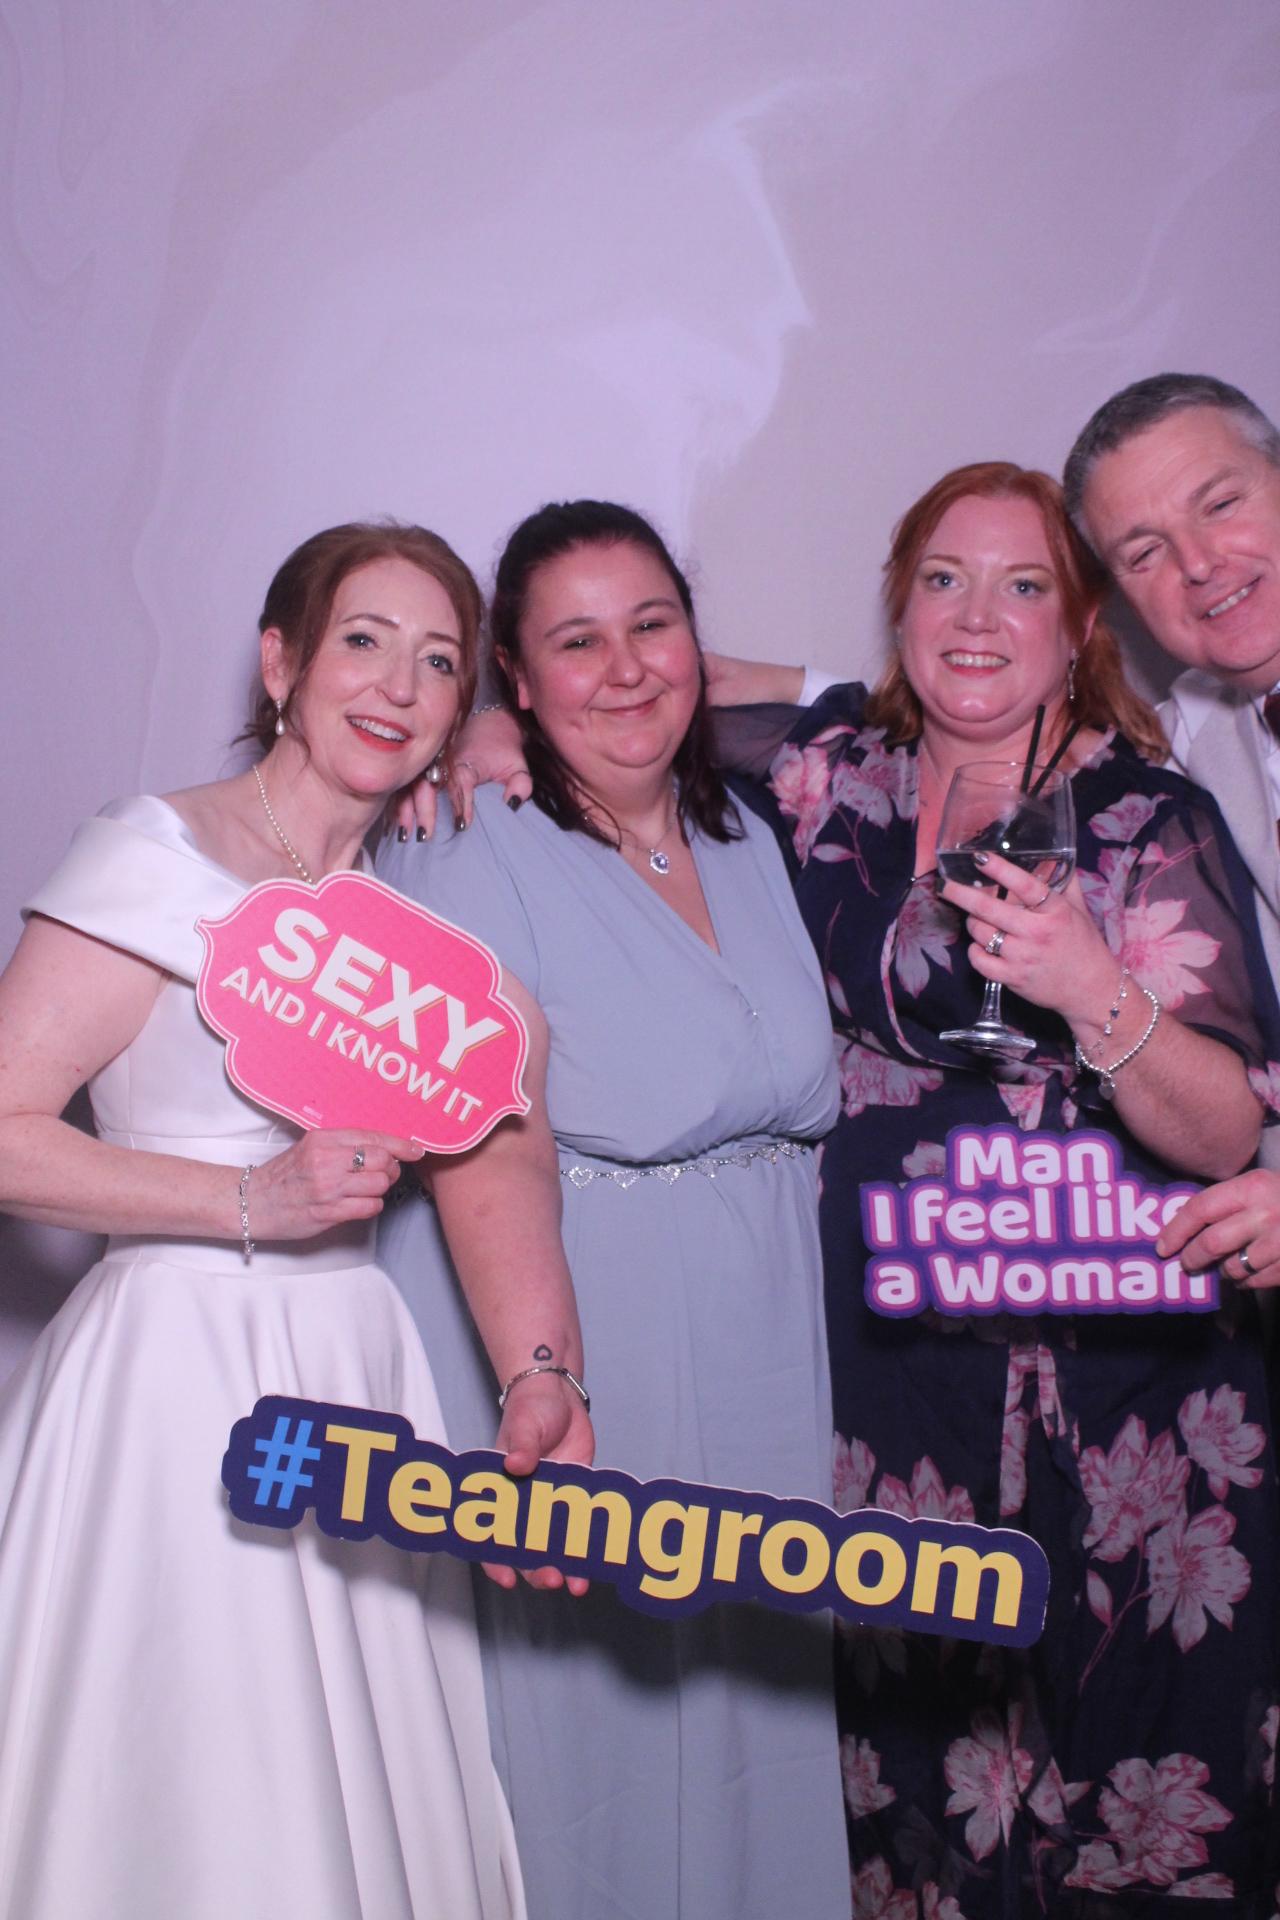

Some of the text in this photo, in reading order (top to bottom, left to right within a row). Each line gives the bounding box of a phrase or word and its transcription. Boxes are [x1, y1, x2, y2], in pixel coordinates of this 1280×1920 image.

[258, 908, 506, 1073] SEXY
[219, 966, 483, 1122] AND I KNOW IT
[959, 1136, 1109, 1186] Man
[875, 1195, 892, 1242] I
[913, 1187, 1052, 1242] feel
[877, 1255, 1206, 1305] a Woman
[247, 1415, 1025, 1627] #Teamgroom
